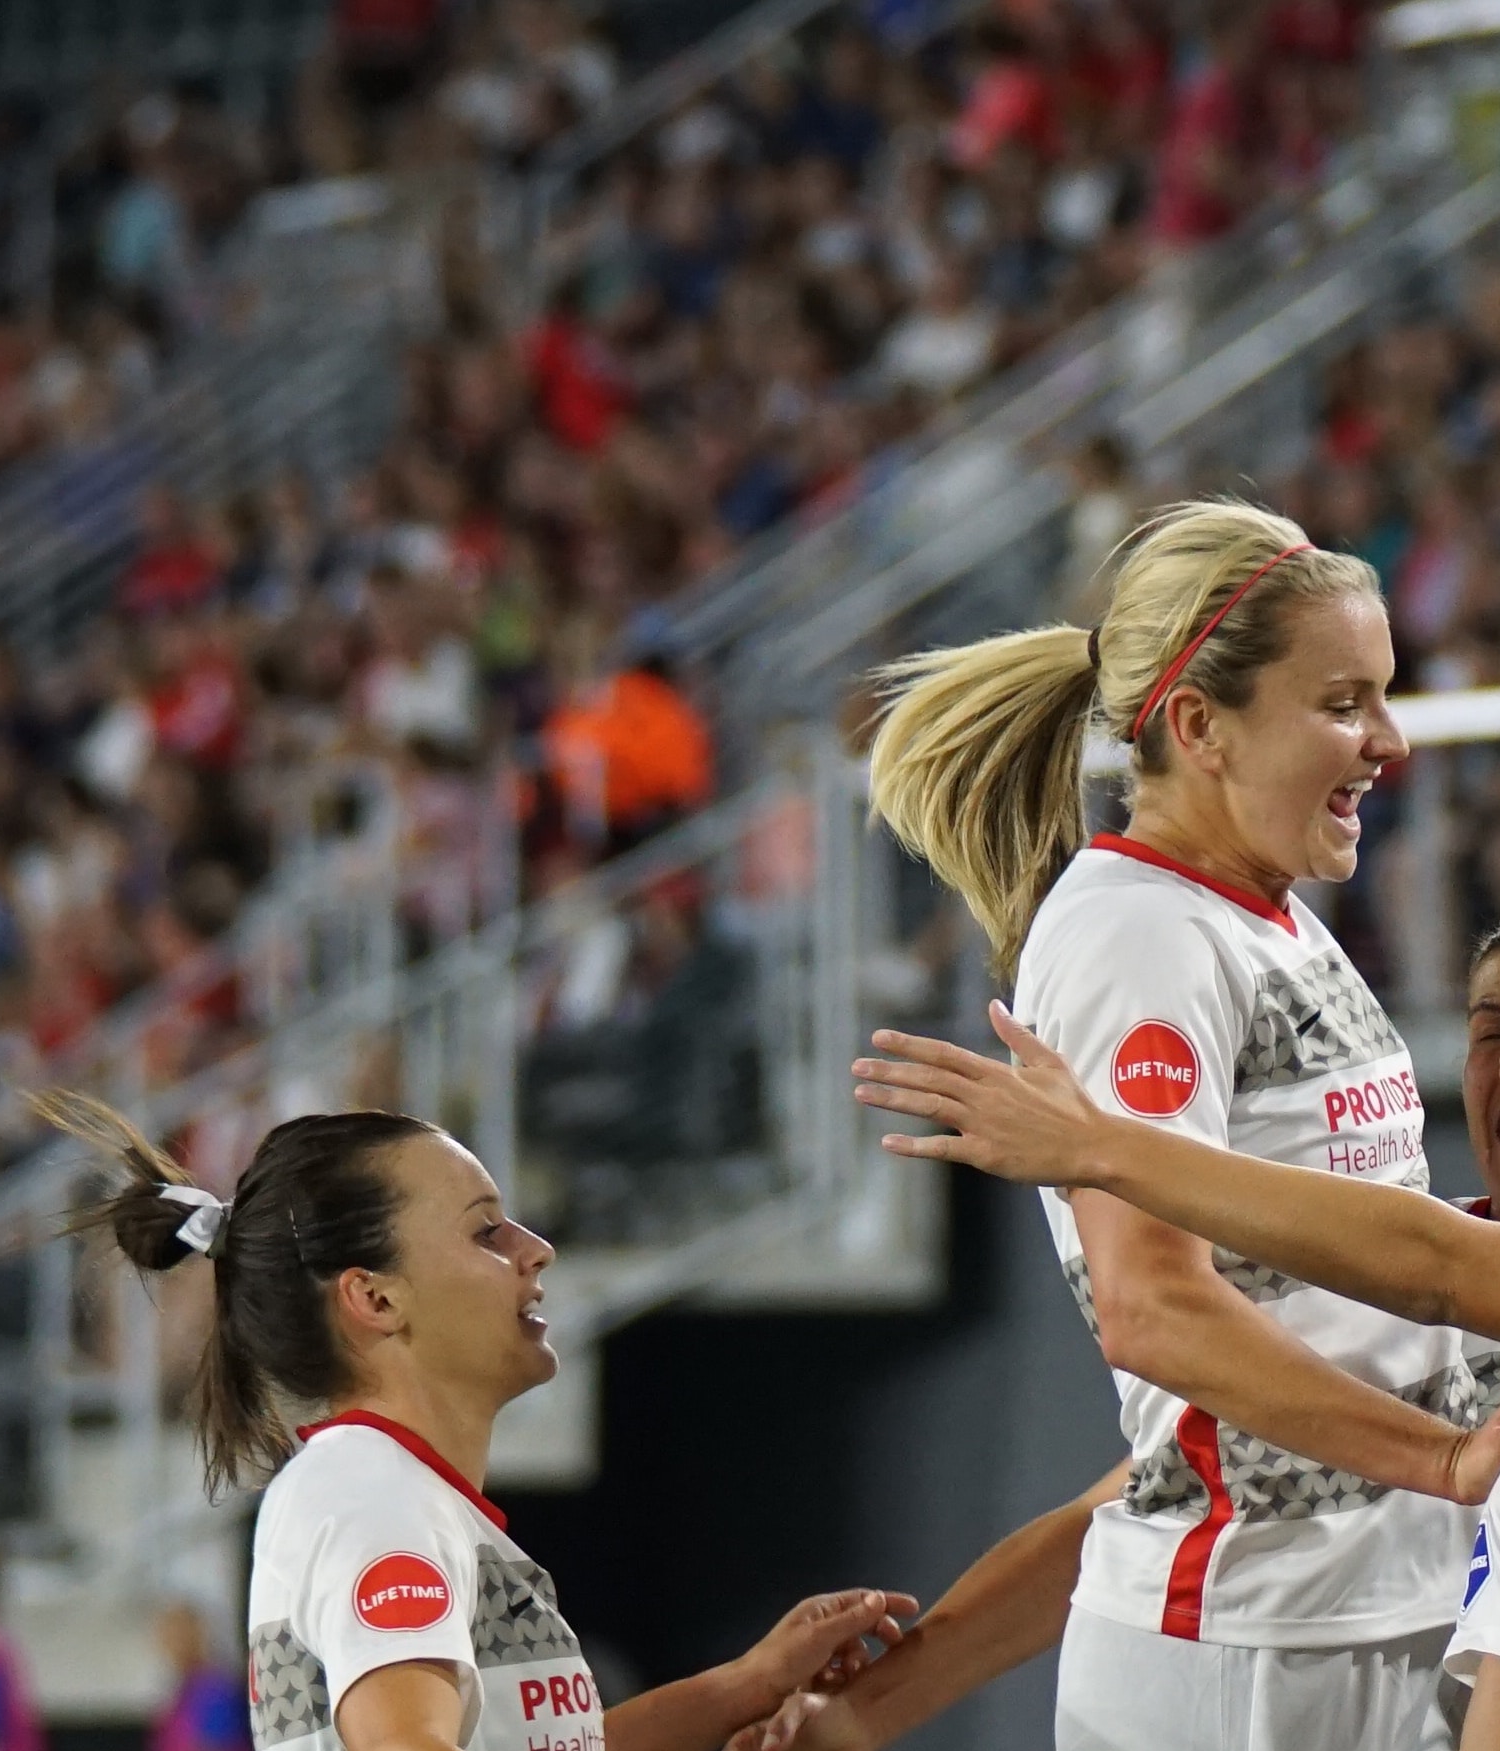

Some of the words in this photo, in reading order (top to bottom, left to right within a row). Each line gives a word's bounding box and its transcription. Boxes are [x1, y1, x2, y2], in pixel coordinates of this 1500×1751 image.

[1117, 1060, 1193, 1084] LIFETIME
[1328, 1130, 1398, 1174] Health
[360, 1585, 446, 1612] LIFETIME
